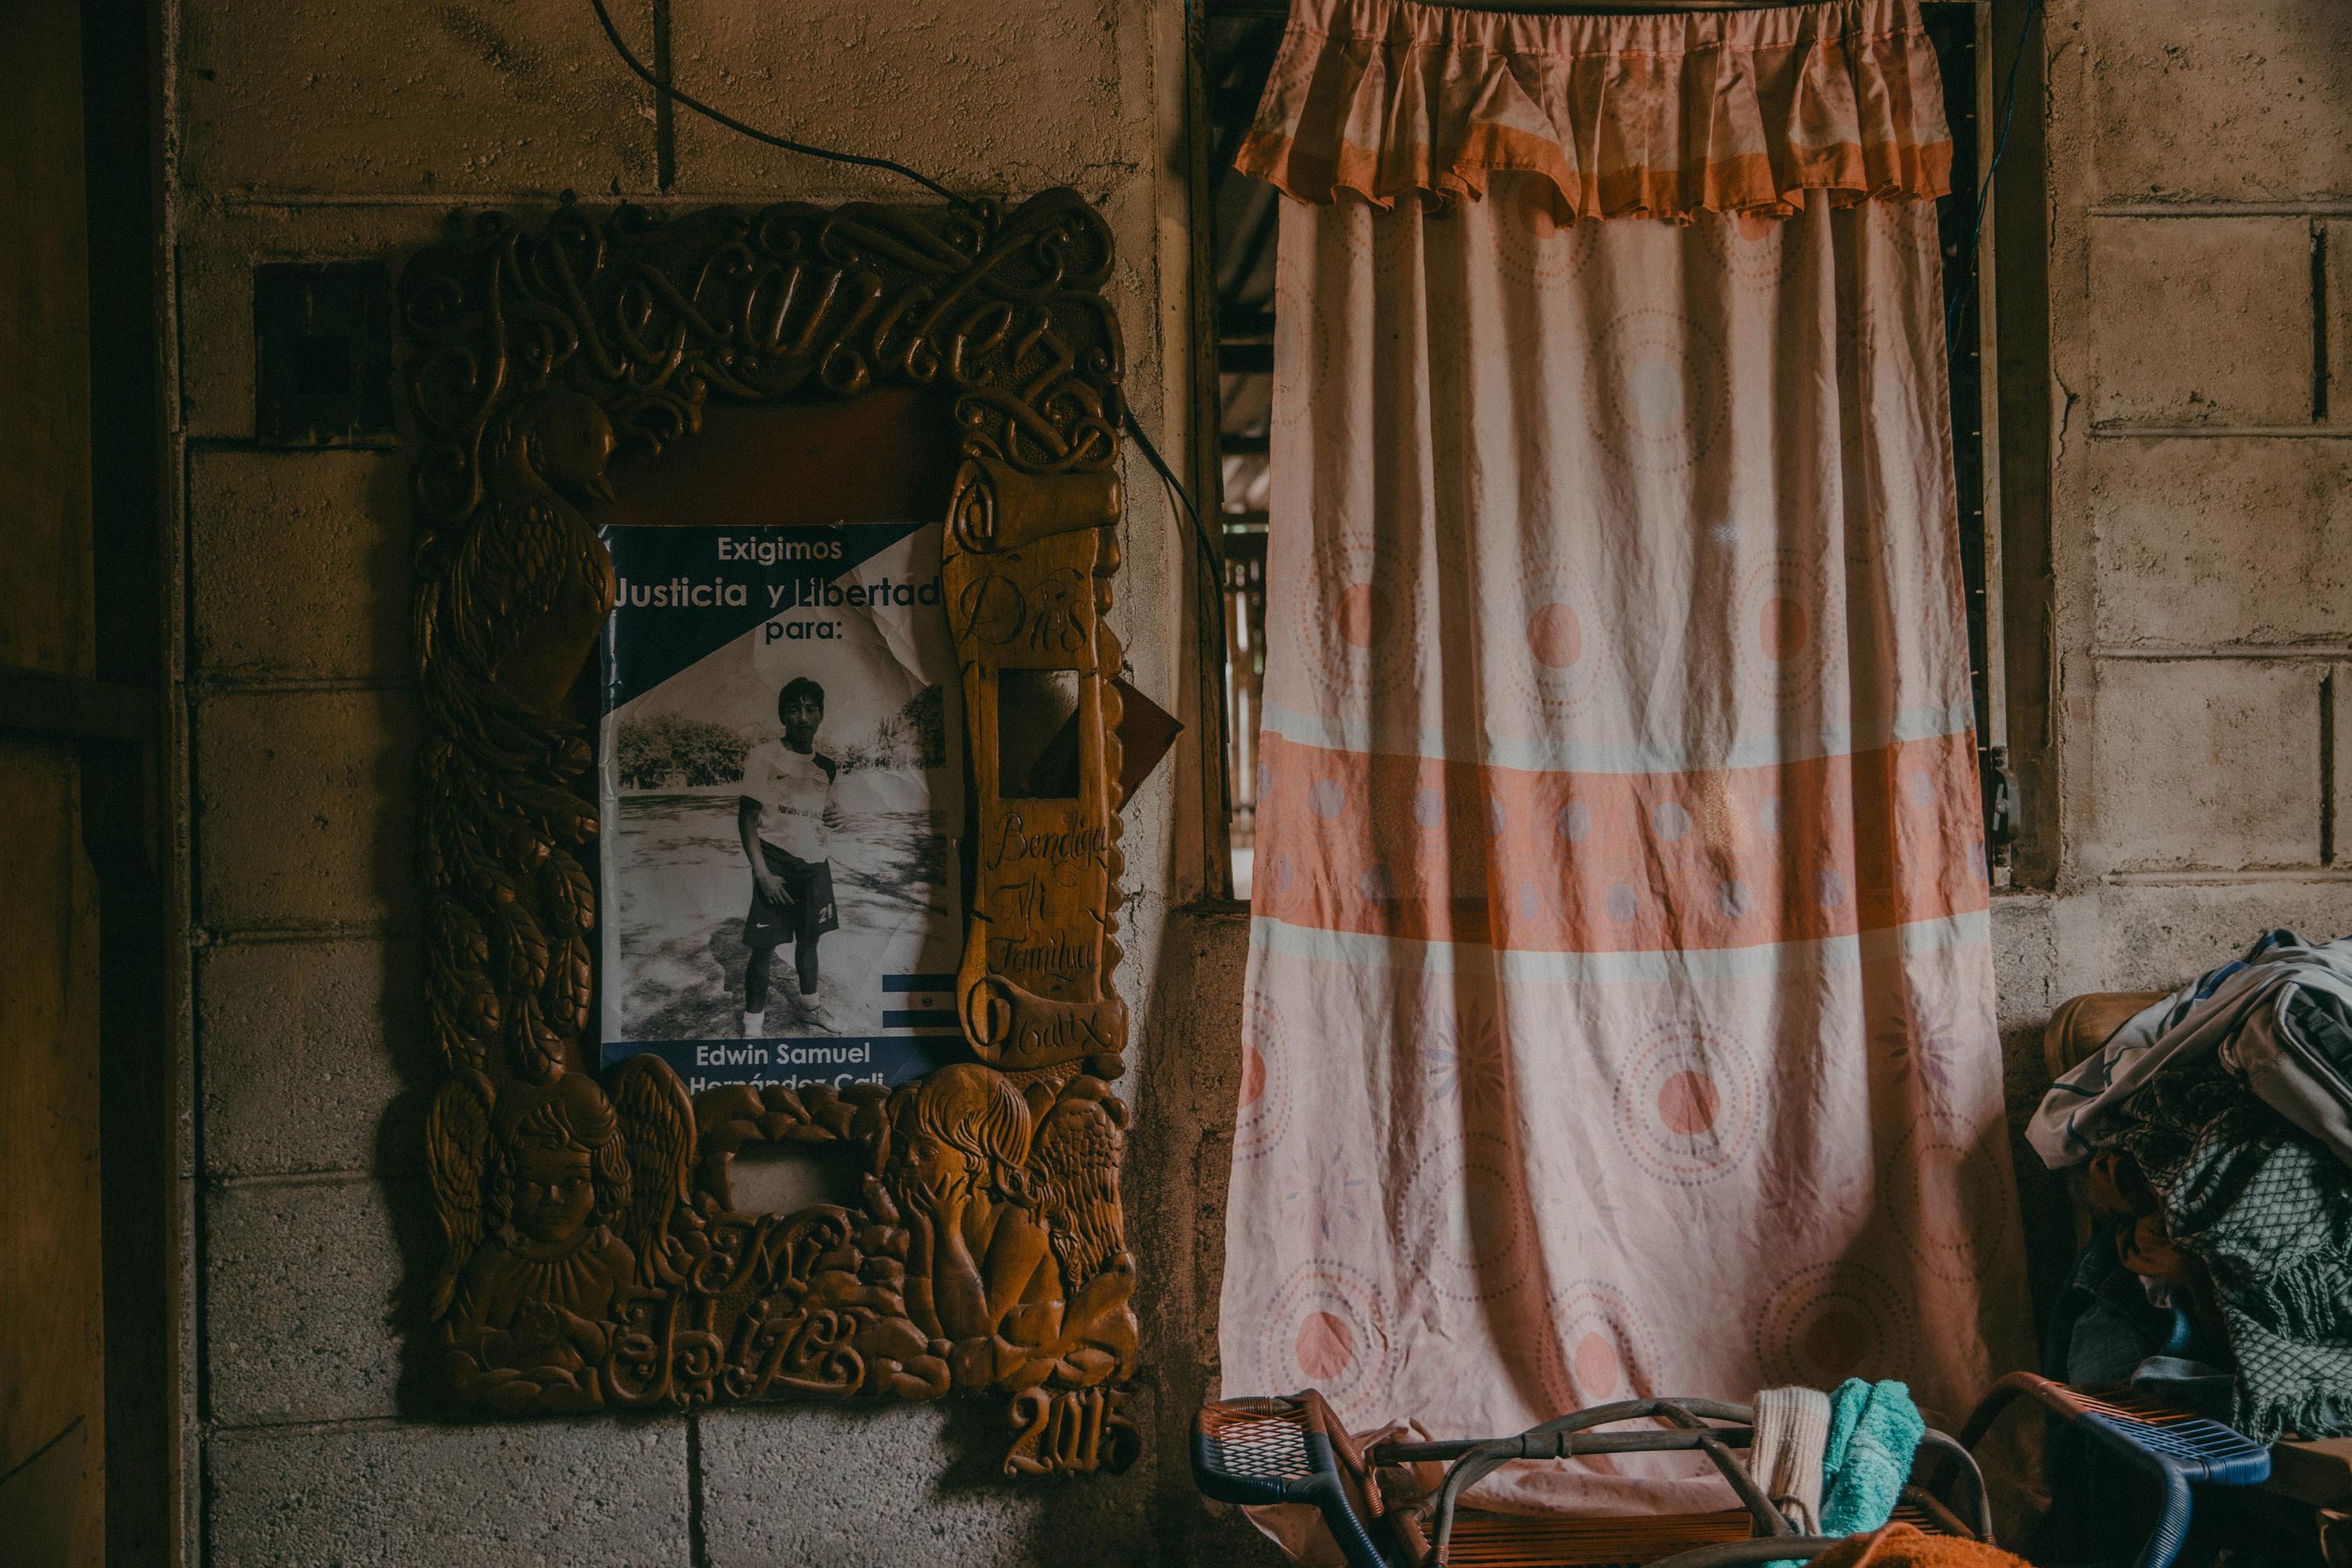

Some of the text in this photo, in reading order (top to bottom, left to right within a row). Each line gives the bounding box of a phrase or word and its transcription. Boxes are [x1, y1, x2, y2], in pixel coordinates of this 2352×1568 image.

[717, 535, 843, 566] Exigimos
[613, 576, 939, 608] Justicia y Libertad
[765, 620, 843, 644] para:
[985, 811, 1108, 880] Bendiga
[818, 902, 833, 924] 21
[990, 871, 1046, 934] Mi
[695, 1042, 870, 1066] Edwin Samuel
[690, 1073, 827, 1096] Heáde
[1004, 1385, 1142, 1479] 2015
